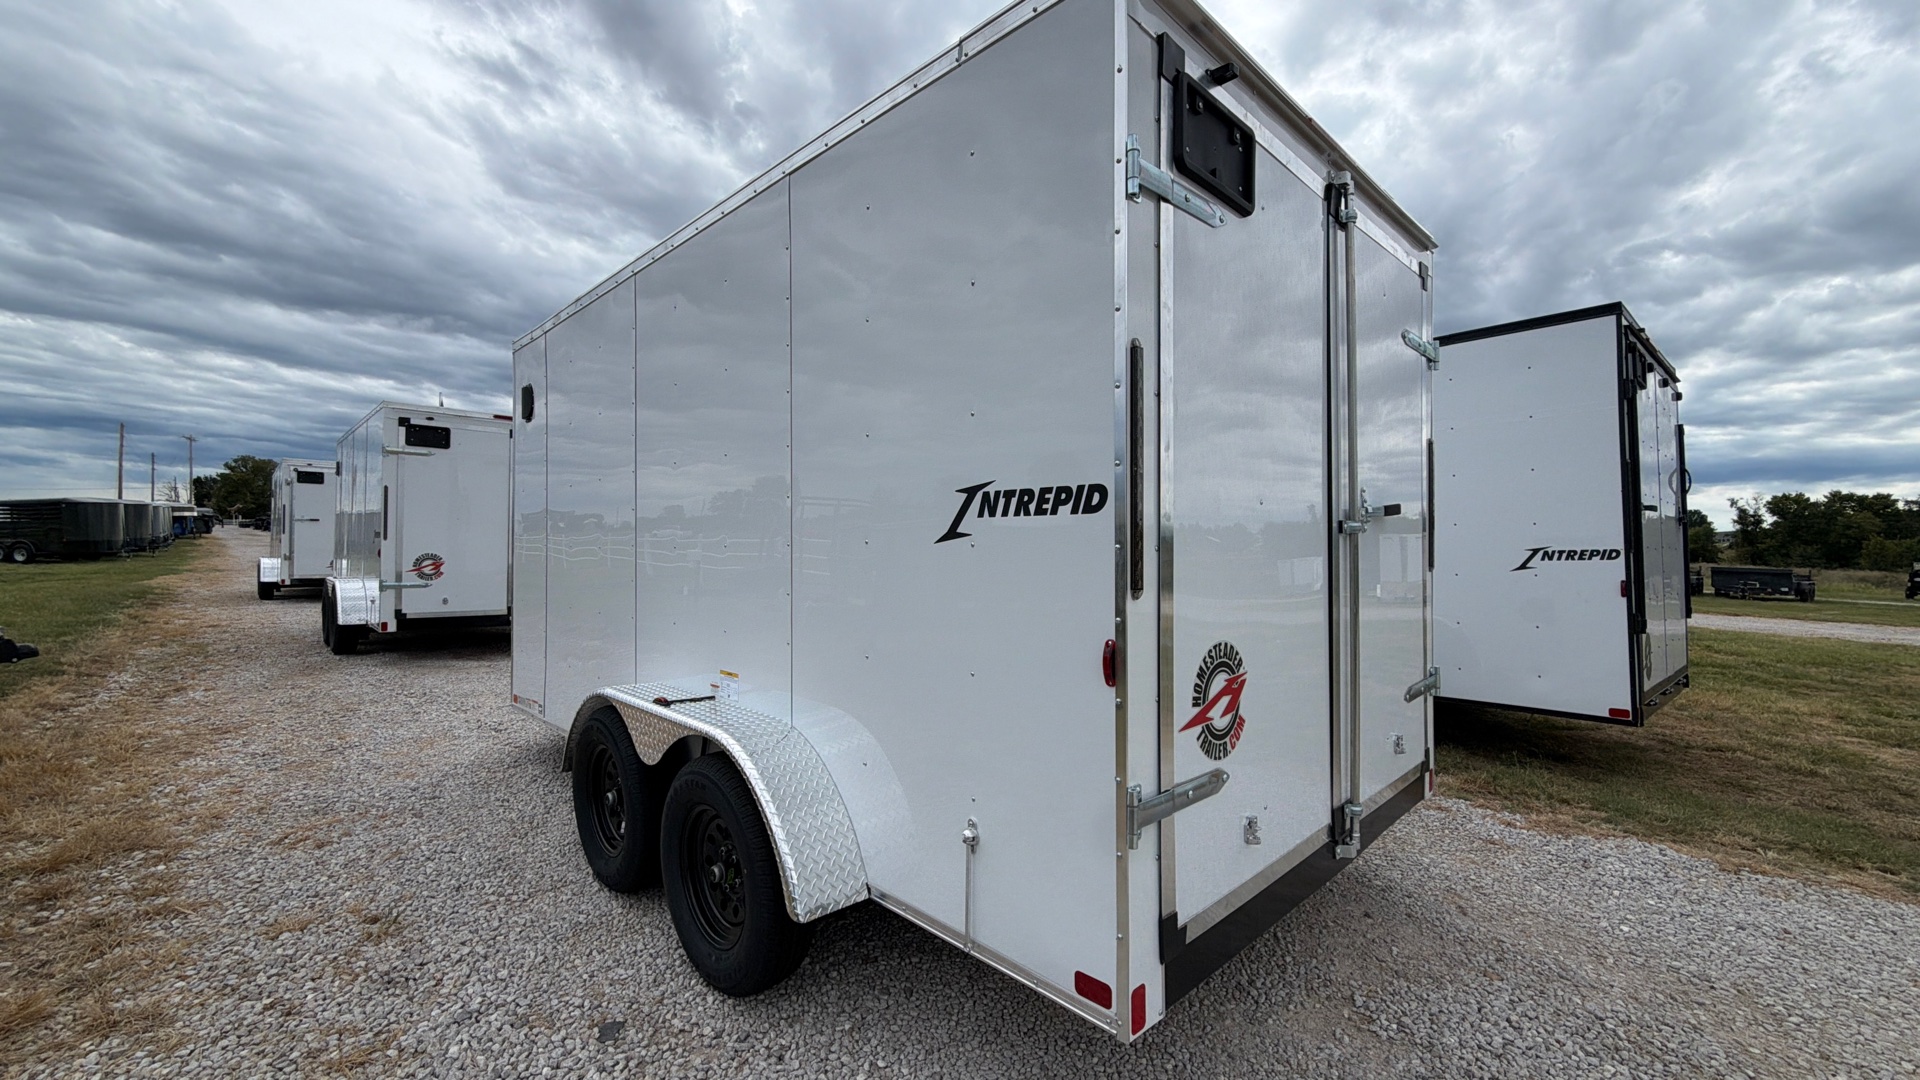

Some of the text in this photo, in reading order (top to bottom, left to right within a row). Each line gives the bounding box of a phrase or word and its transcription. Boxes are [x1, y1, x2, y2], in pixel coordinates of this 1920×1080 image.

[934, 480, 1109, 544] INTREPID
[1509, 546, 1621, 572] INTREPID
[1191, 642, 1244, 707] HOMESTEADER
[1196, 714, 1246, 760] TRAILER.COM
